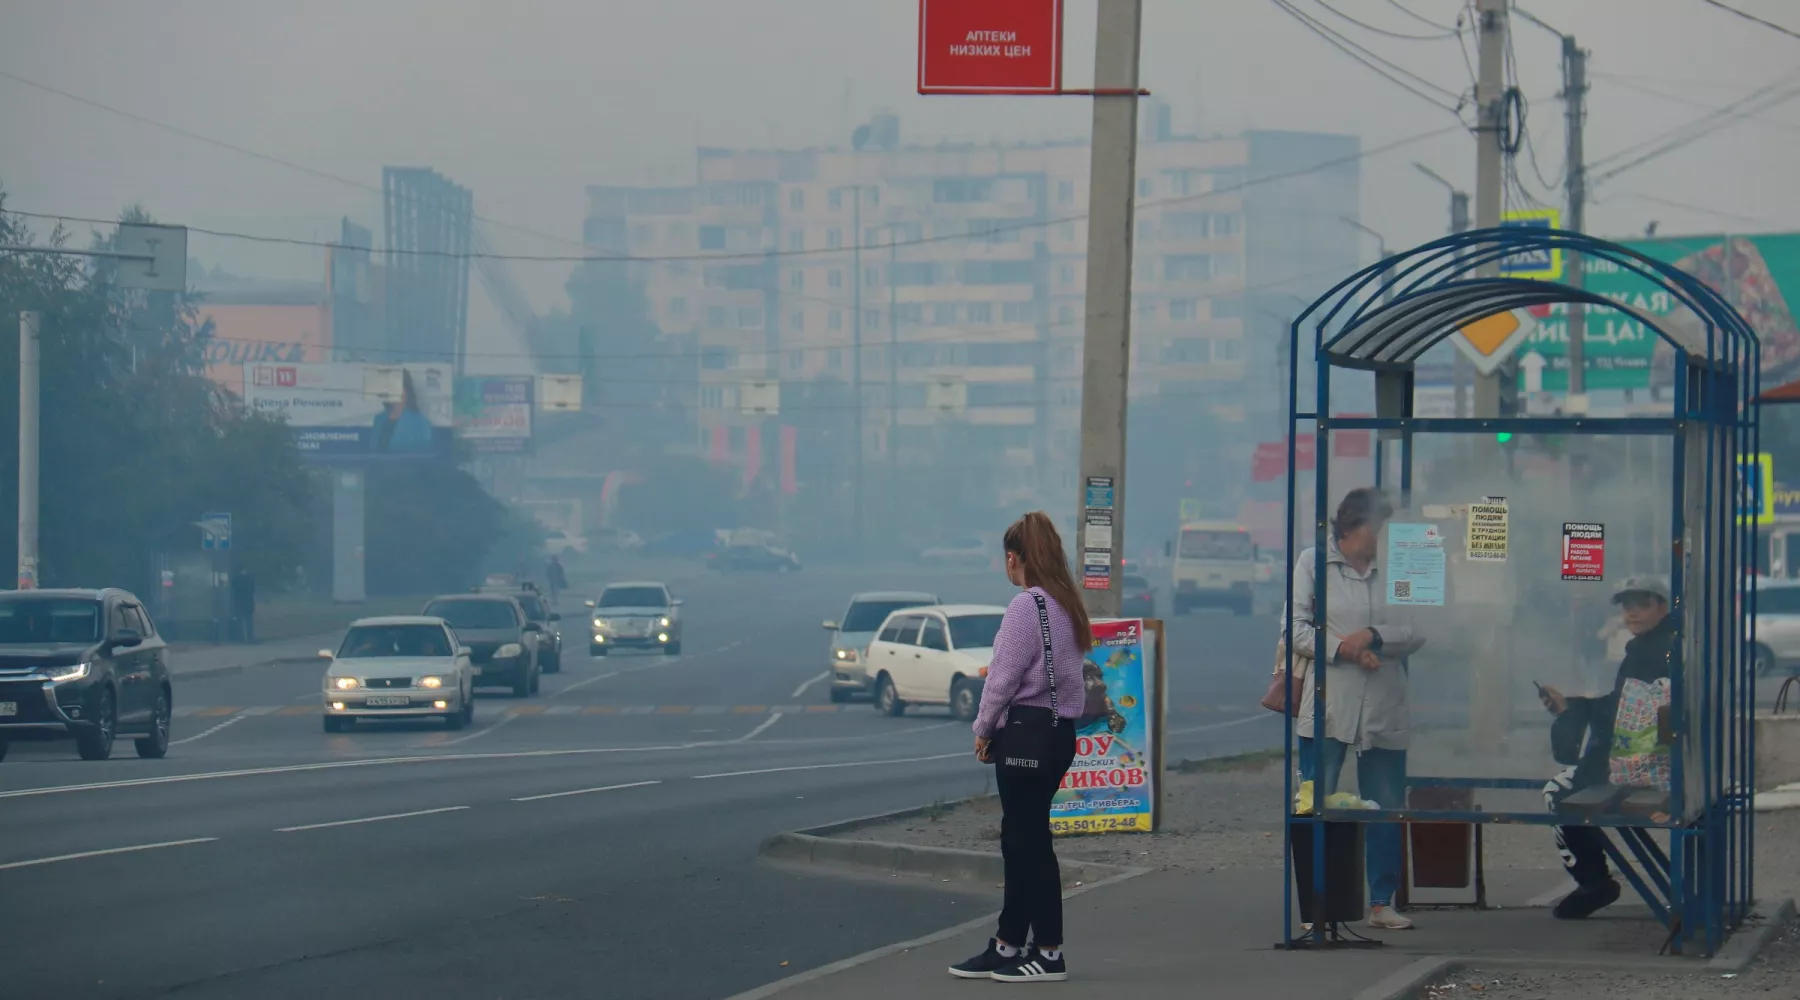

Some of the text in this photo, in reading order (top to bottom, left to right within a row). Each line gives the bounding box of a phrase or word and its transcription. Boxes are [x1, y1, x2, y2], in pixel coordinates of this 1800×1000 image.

[966, 30, 1016, 42] АПТЕКИ
[950, 45, 1031, 58] НИЗКИХ ЦЕН
[1472, 506, 1508, 514] ПОМОЩЬ
[1475, 514, 1503, 522] ЛЮДЯМ
[1565, 523, 1603, 532] ПОМОЩЬ
[1570, 531, 1602, 539] ЛЮДЯМ
[1471, 541, 1483, 549] БЕЗ
[1039, 608, 1051, 646] UNAFFECTED
[1128, 625, 1136, 636] 2
[1105, 638, 1136, 646] октября
[1045, 650, 1055, 687] UNAFFECTED
[1076, 736, 1114, 756] ОУ
[1005, 757, 1040, 768] UNAFFECTED
[1071, 758, 1115, 768] альских
[1067, 801, 1086, 810] ТРЦ
[1087, 798, 1141, 809] «РИВЬЕРА»
